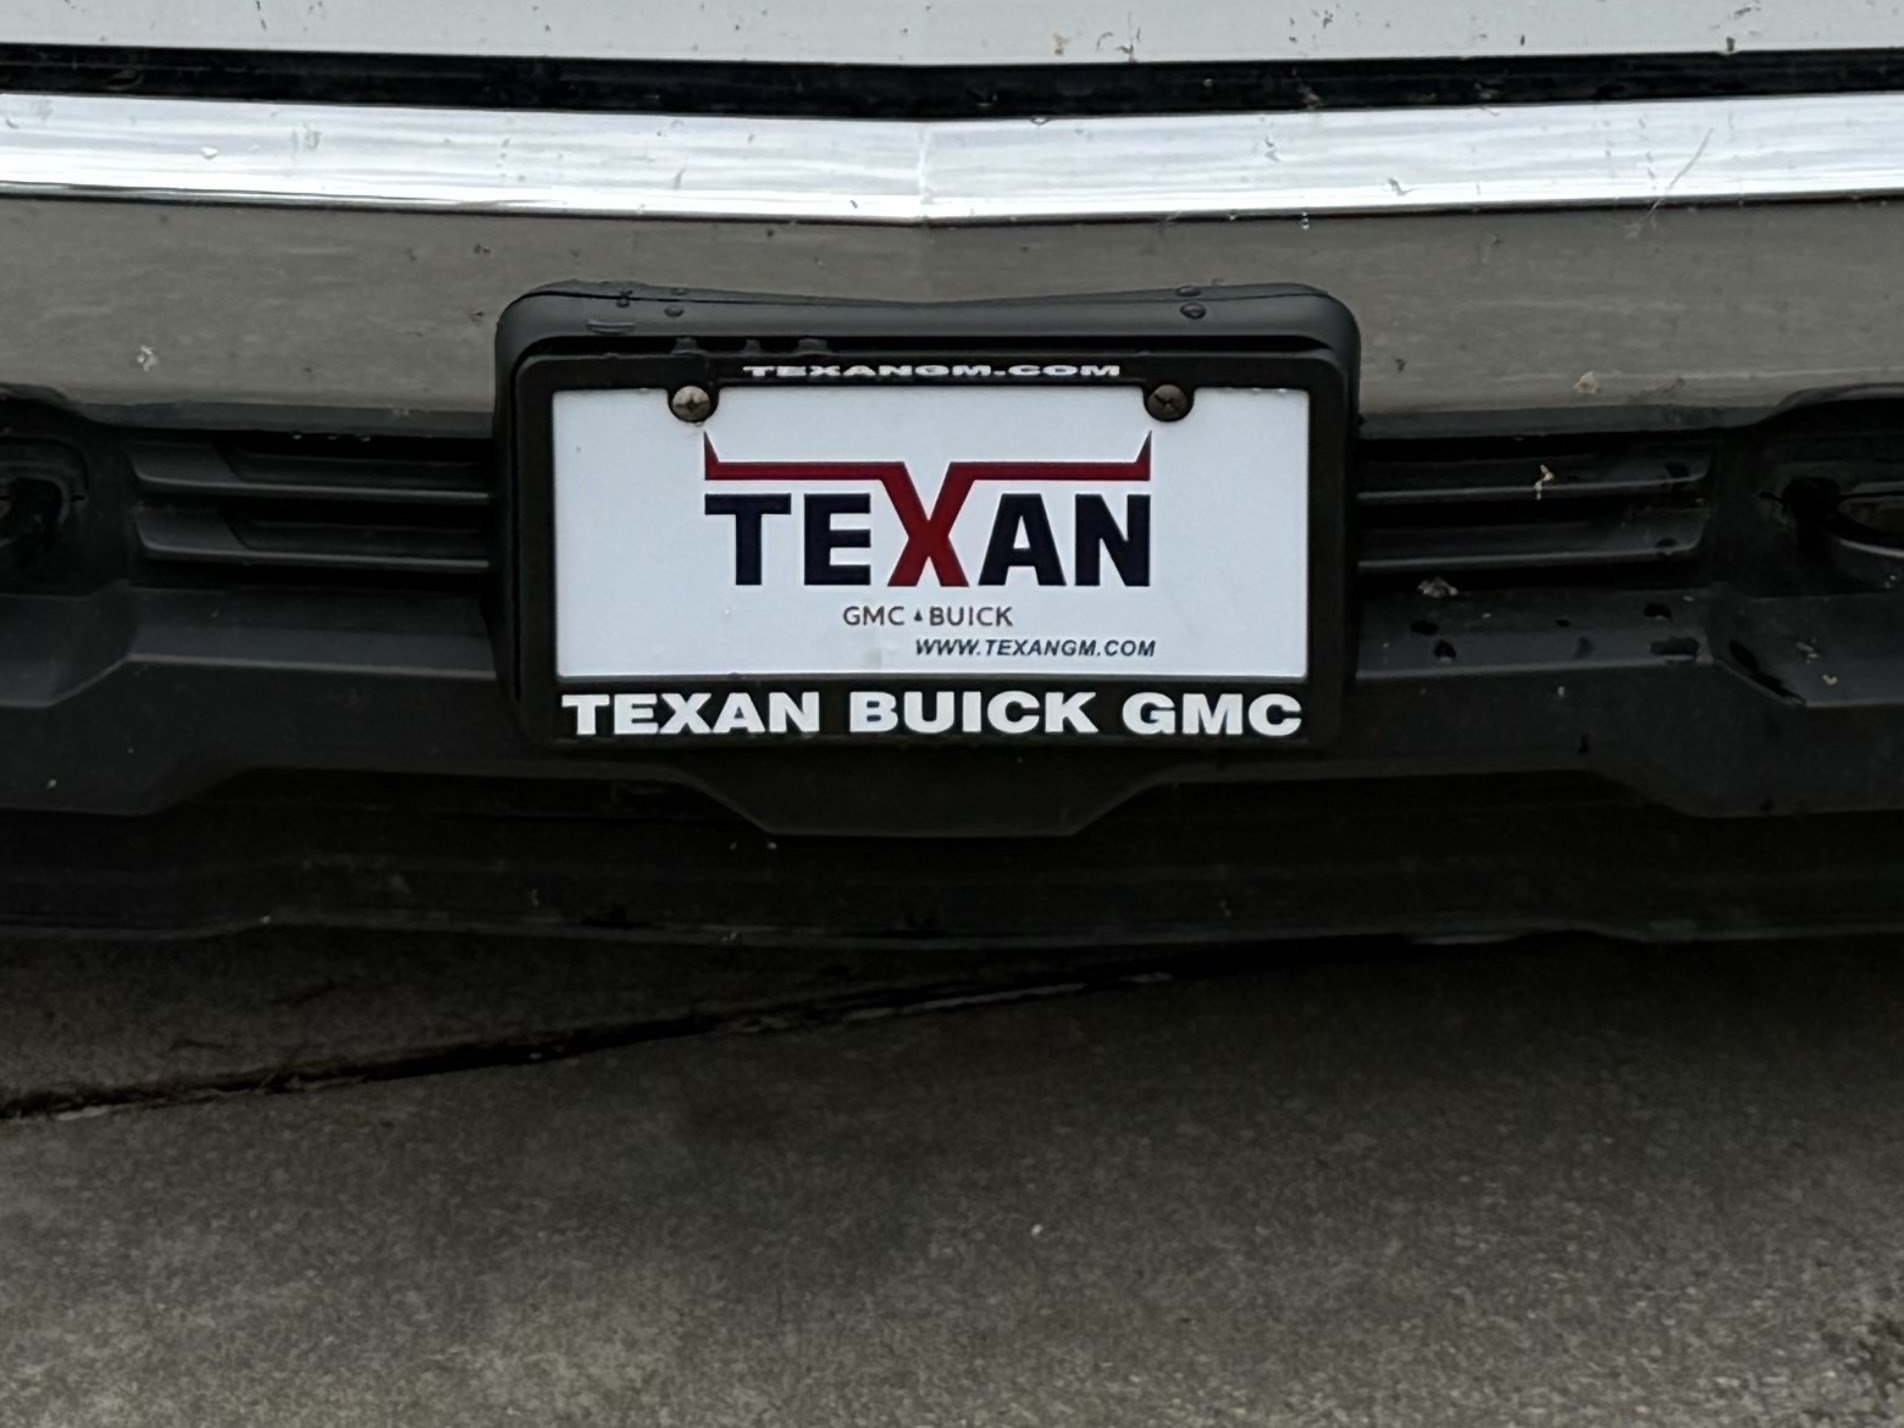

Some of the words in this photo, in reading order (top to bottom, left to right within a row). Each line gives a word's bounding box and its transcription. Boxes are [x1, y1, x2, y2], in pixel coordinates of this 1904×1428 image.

[742, 363, 1121, 378] TEXANGM.COM
[703, 462, 1152, 588] TEXAN
[842, 605, 905, 627] GMC
[928, 605, 1014, 628] BUICK
[914, 637, 1157, 658] WWW.TEXANGM.COM
[560, 690, 821, 737] TEXAN
[848, 689, 1100, 735] BUICK
[1121, 690, 1303, 738] GMC
